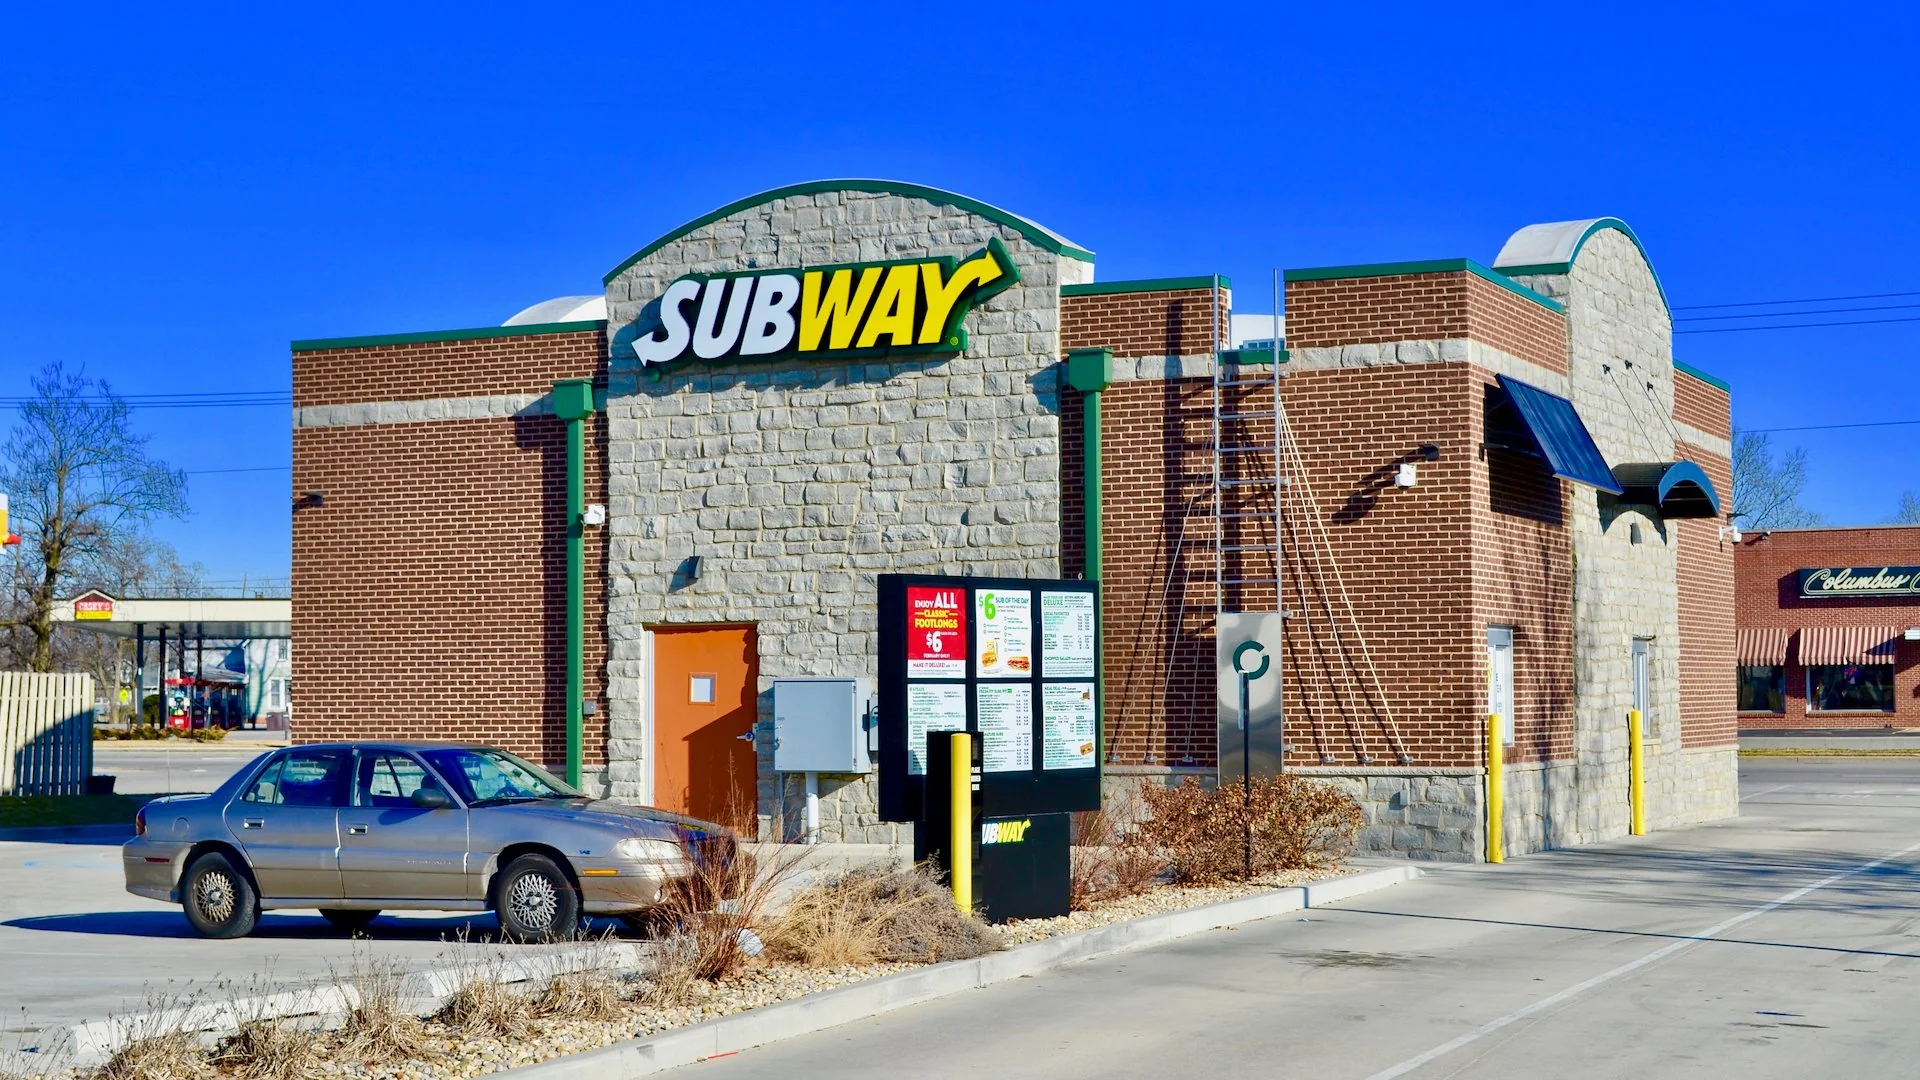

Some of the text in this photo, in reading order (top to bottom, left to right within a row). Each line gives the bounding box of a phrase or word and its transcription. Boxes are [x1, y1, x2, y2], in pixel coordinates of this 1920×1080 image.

[631, 250, 1003, 367] SUBWAY
[1803, 567, 1912, 595] Columbus
[914, 592, 958, 609] ENJOY ALL
[914, 618, 958, 629] FOOTLONGS
[924, 609, 950, 618] CLASSIC
[926, 630, 943, 653] $6
[982, 819, 1031, 845] UBWAY
